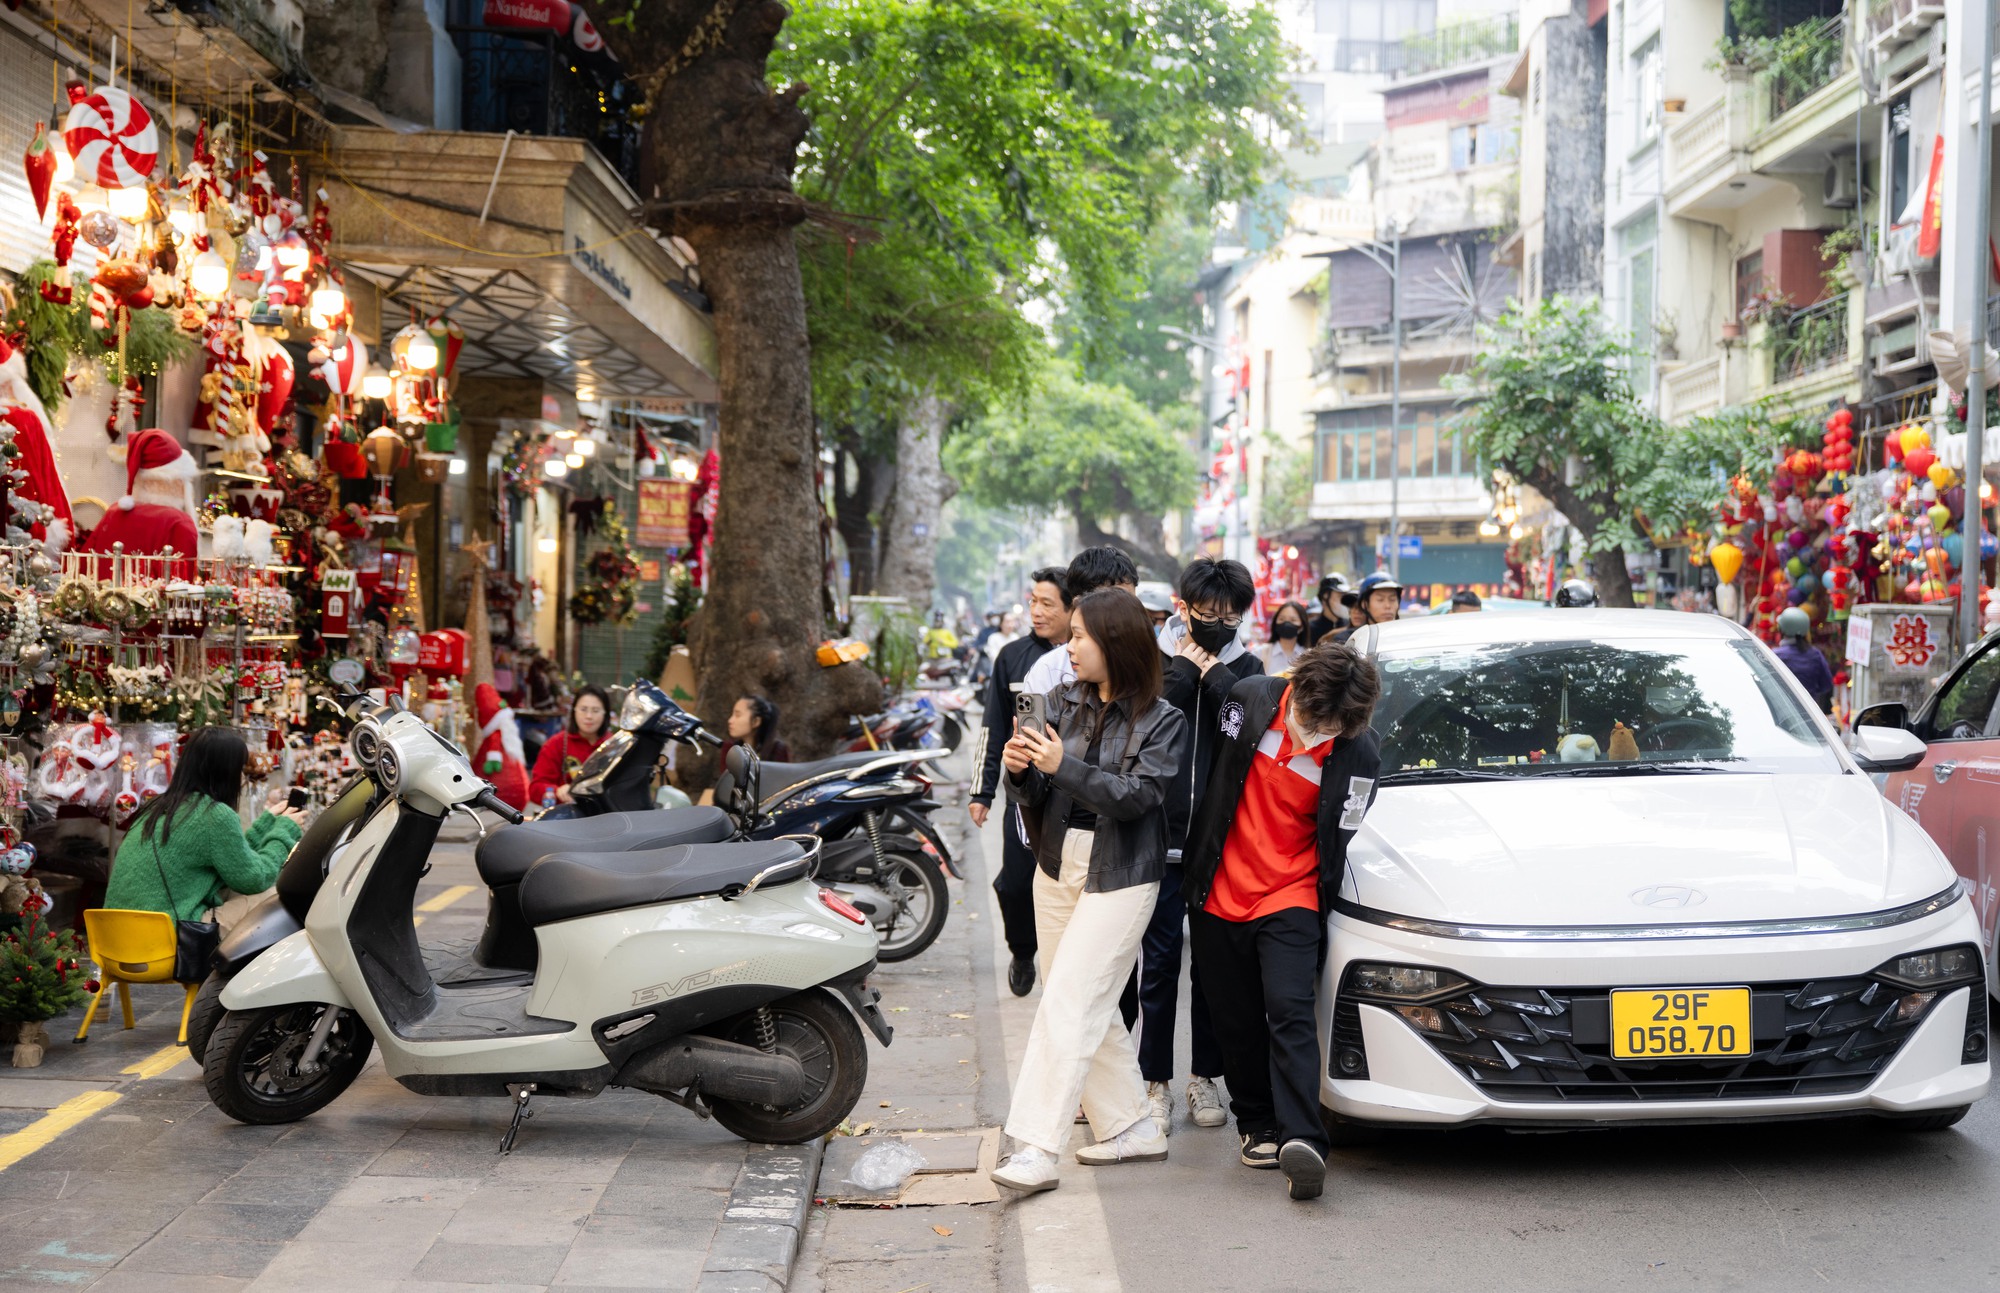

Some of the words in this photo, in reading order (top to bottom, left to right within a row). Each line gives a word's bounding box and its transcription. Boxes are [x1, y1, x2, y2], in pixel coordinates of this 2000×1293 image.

[494, 0, 551, 24] Navidad
[632, 968, 717, 1007] EVO
[1652, 993, 1709, 1021] 29F
[1628, 1024, 1735, 1053] 058.70
